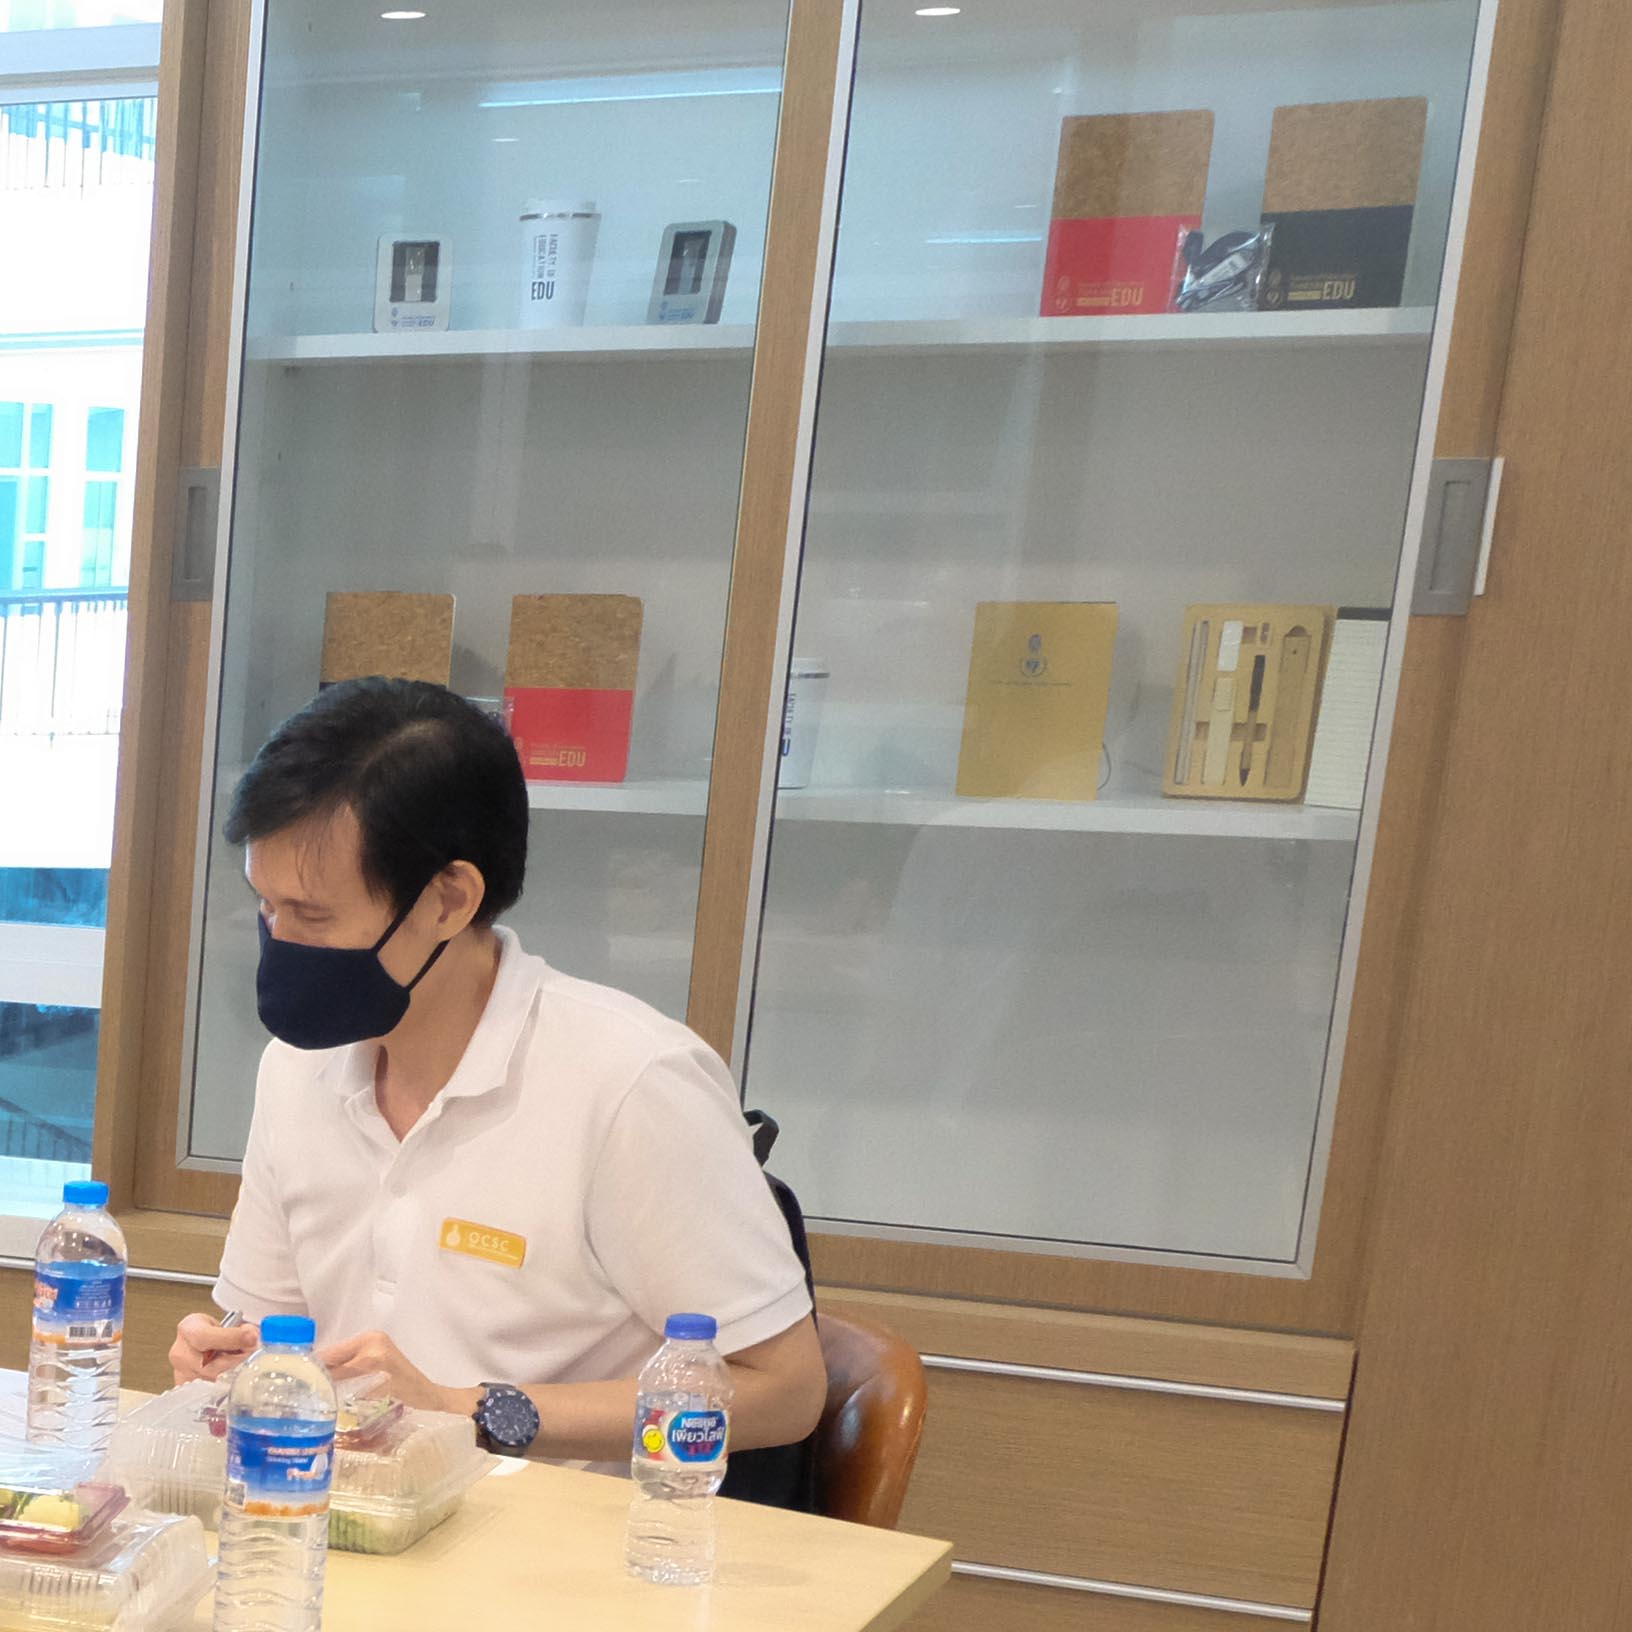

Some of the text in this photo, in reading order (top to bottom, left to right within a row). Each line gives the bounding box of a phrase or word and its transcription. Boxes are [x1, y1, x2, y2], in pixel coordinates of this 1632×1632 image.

[531, 281, 555, 301] EDU
[1110, 286, 1144, 306] EDU
[1322, 280, 1356, 300] EDU
[558, 750, 587, 767] EDU
